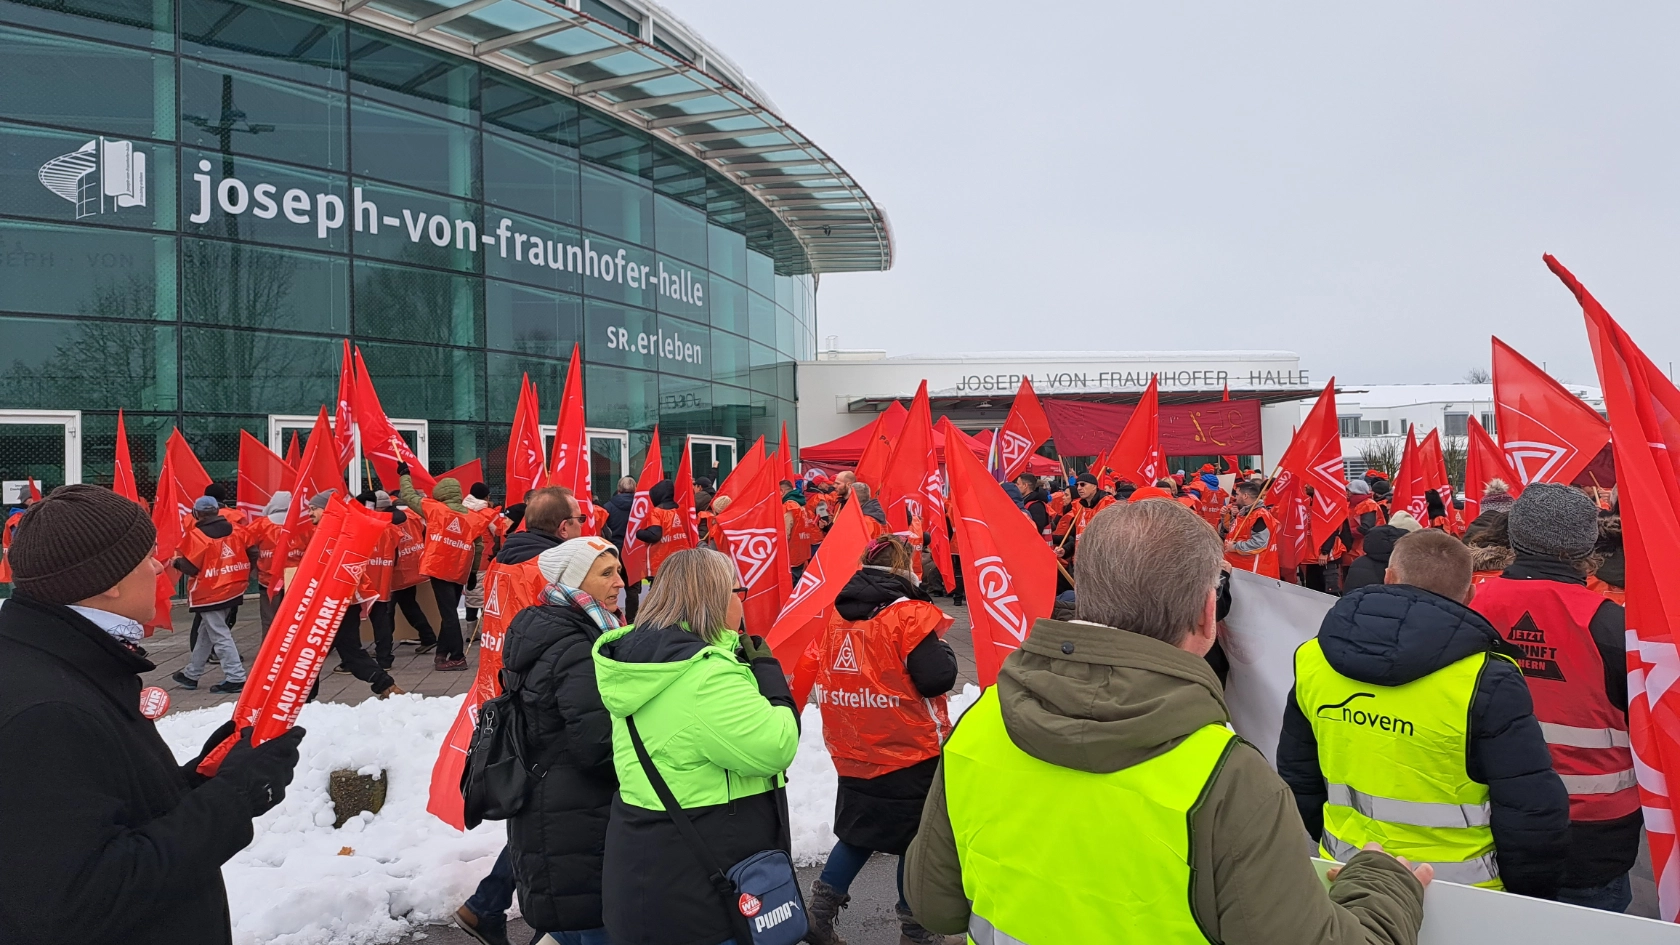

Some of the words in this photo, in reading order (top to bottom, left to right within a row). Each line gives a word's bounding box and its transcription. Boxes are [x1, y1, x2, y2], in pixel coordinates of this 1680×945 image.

[189, 159, 703, 306] joseph-von-fraunhofer-halle
[606, 325, 702, 365] SR.erleben
[1046, 372, 1087, 388] VON
[1099, 370, 1228, 388] FRAUNHOFER
[1250, 369, 1309, 386] HALLE
[1511, 629, 1543, 641] JETZT
[272, 681, 301, 722] LAUT
[290, 647, 316, 680] UND
[307, 596, 340, 646] STARK
[144, 690, 162, 715] WIR
[830, 687, 900, 709] streiken
[1342, 705, 1414, 737] novem
[754, 902, 792, 933] PUMA
